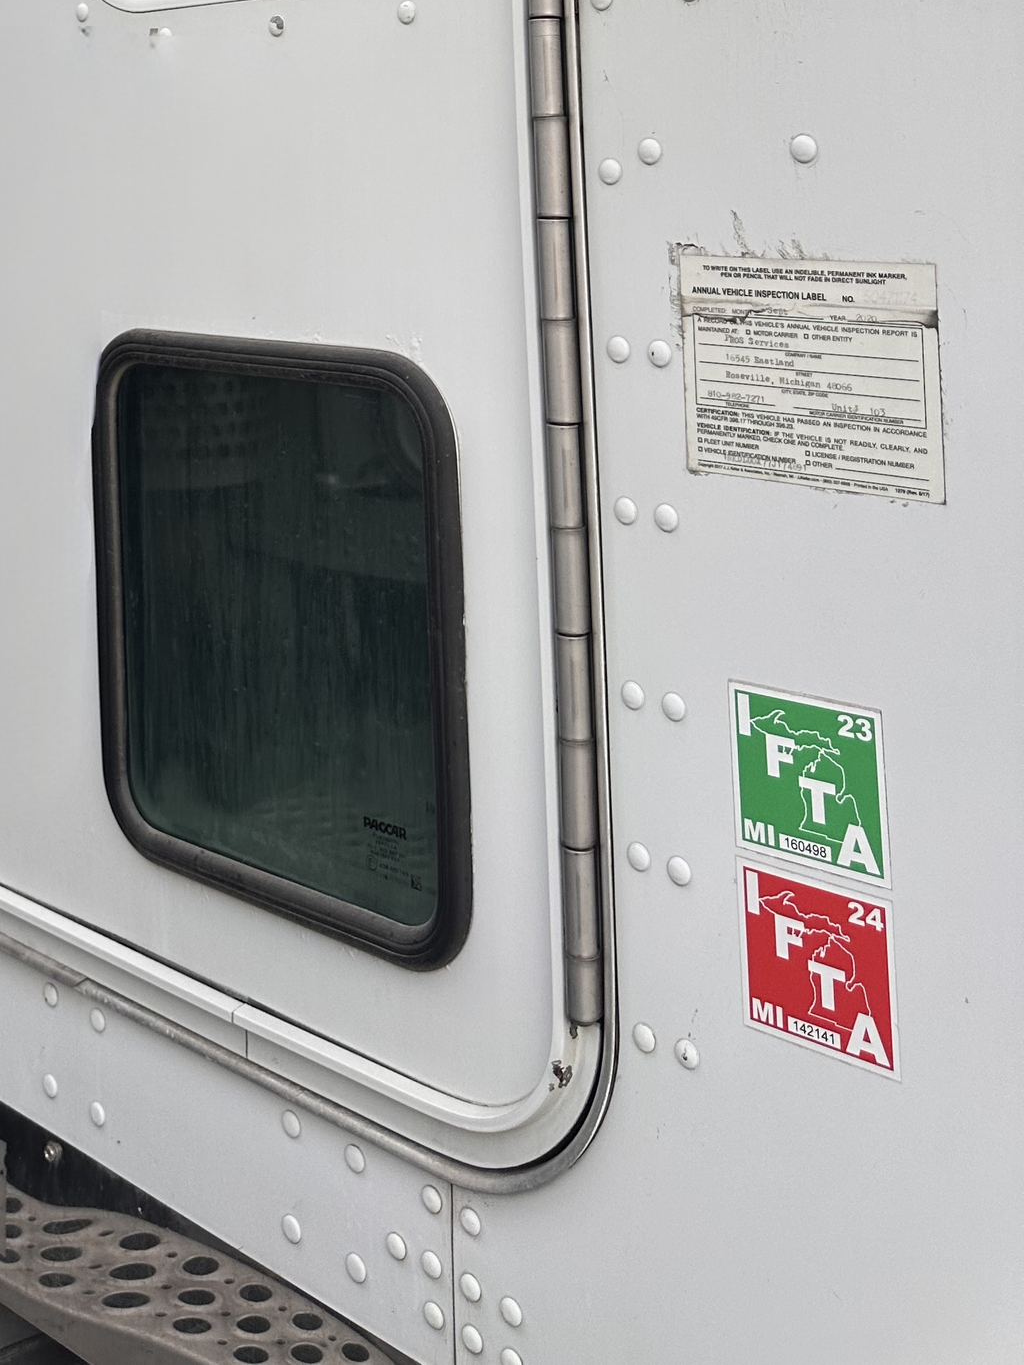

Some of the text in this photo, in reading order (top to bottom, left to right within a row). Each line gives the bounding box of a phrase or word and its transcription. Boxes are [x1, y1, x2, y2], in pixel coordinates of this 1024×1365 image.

[692, 287, 826, 301] ANNUAL VEHICLE INSPECTION LABEL
[856, 314, 878, 322] 2020
[698, 326, 730, 334] MAINTAINED
[841, 327, 879, 335] INSPECTION
[749, 338, 789, 349] Services
[754, 356, 794, 367] Eastland
[780, 378, 821, 388] Michigan
[696, 407, 740, 417] CERTIFICATION:
[756, 414, 780, 422] VEHICLE
[797, 418, 821, 426] PASSED
[834, 423, 871, 432] INSPECTION
[882, 428, 928, 438] ACCORDANCE
[748, 419, 775, 427] THROUGH
[697, 422, 721, 431] VEHICLE
[724, 425, 772, 436] IDENTIFICATION:
[796, 434, 823, 442] VEHICLE
[697, 428, 736, 438] PERMANENTLY
[783, 438, 796, 446] ONE
[704, 447, 727, 456] VEHICLE
[736, 442, 759, 450] NUMBER
[812, 452, 837, 460] LICENSE
[842, 455, 886, 466] REGISTRATION
[888, 461, 915, 469] NUMBER
[837, 714, 873, 742] 23
[363, 816, 407, 840] PACCAR
[744, 818, 827, 859] MI 160498
[848, 902, 884, 932] 24
[752, 998, 836, 1045] MI 142141
